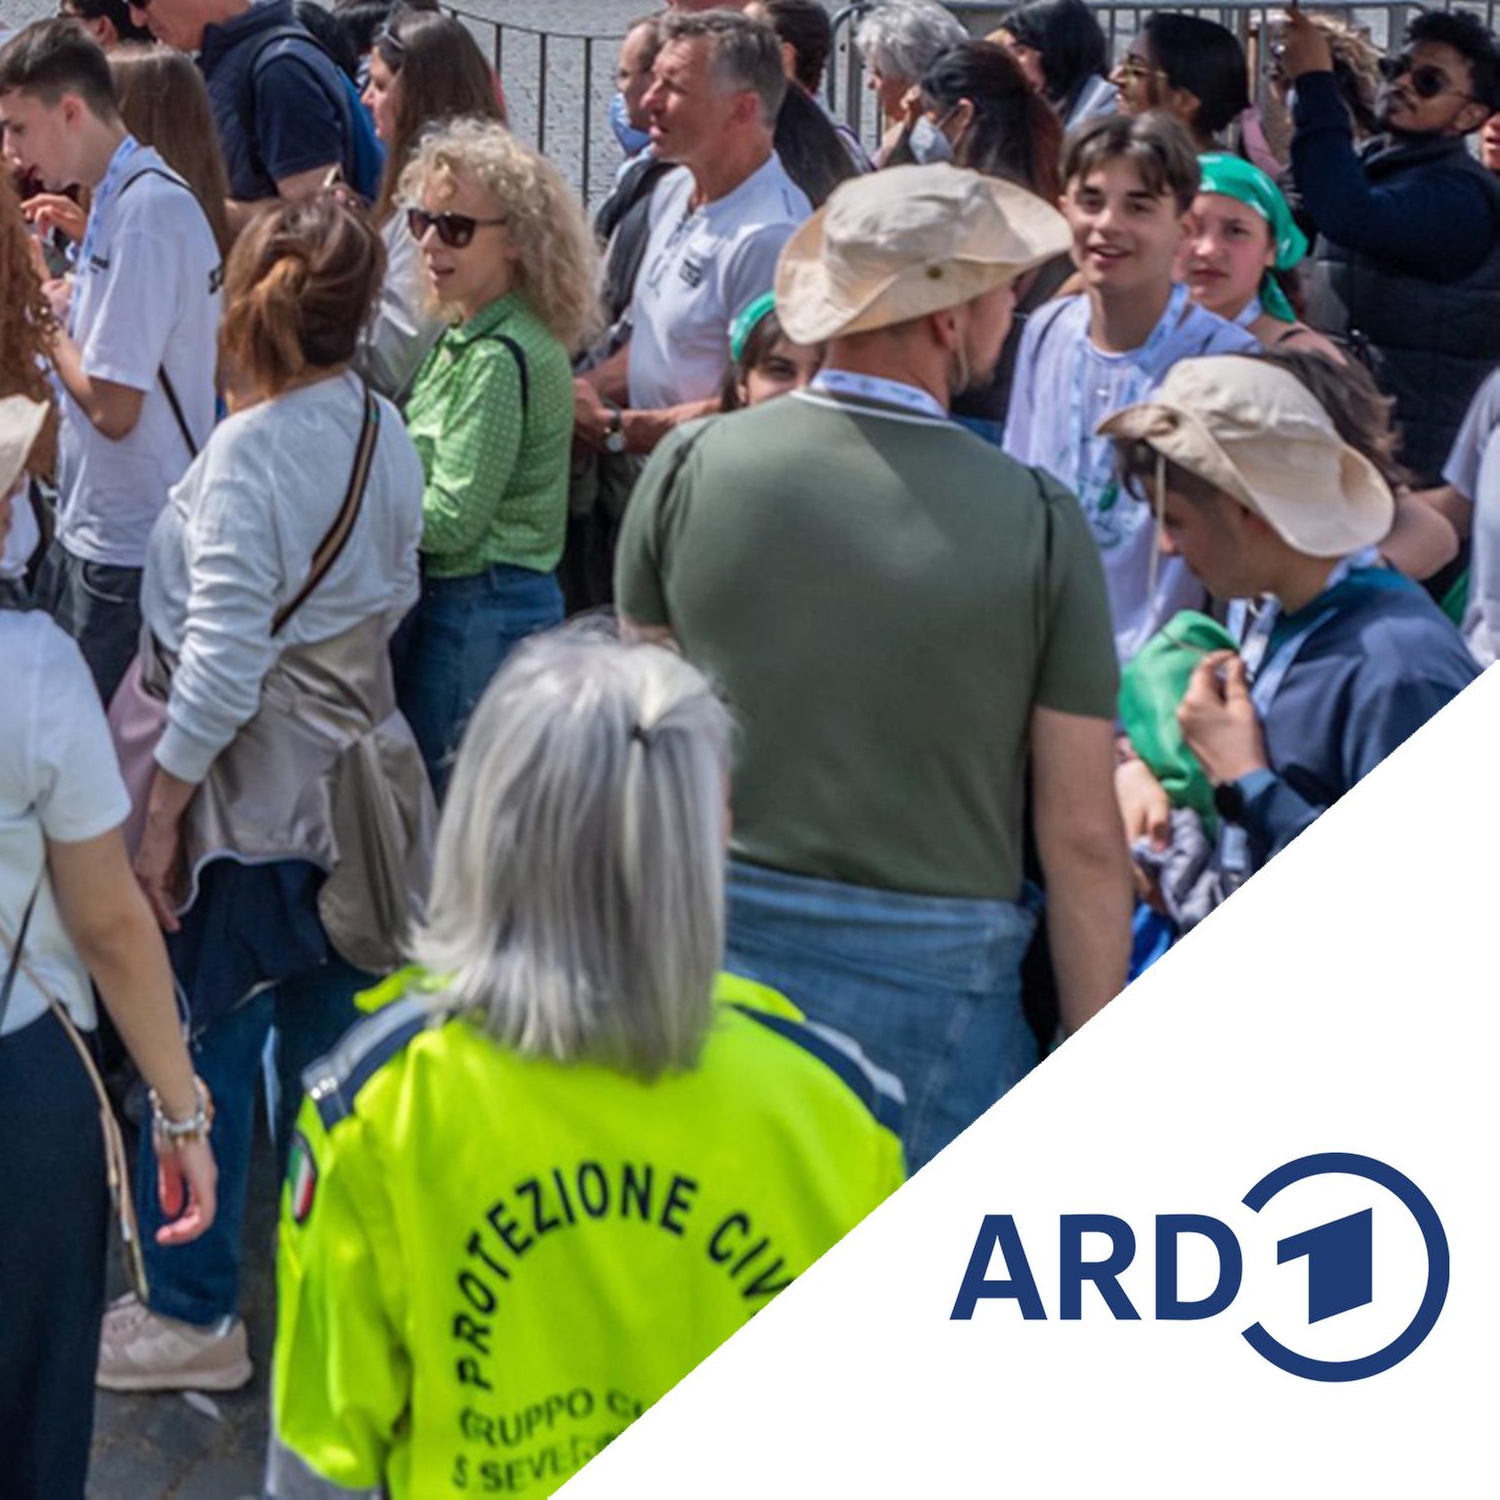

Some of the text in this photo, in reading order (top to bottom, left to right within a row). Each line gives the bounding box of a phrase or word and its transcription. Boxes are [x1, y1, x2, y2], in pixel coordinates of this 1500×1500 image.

[452, 1160, 795, 1392] PROTEZIONE CIV
[459, 1387, 595, 1447] GRUPPO
